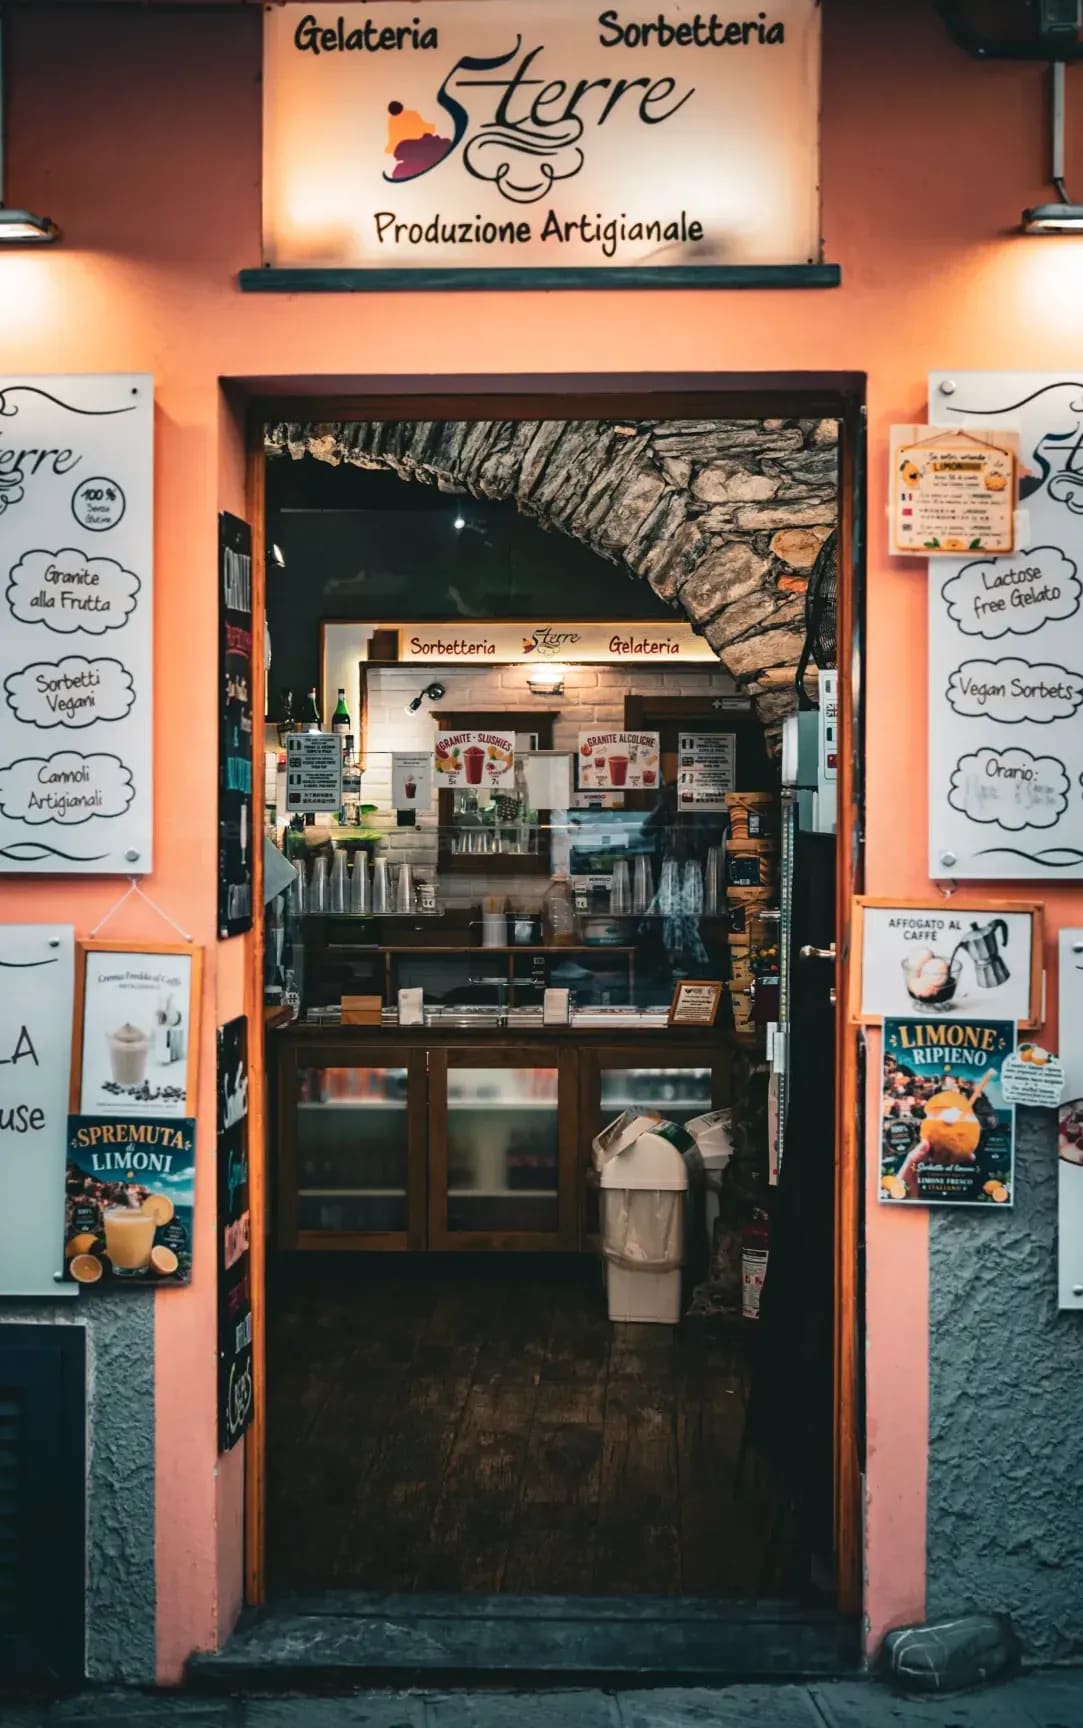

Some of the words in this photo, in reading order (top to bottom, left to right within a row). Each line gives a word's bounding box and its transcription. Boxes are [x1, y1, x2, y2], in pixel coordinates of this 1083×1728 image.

[294, 14, 438, 54] Gelateria
[599, 11, 784, 48] Sorbetteria
[375, 211, 532, 245] Produzione
[540, 210, 704, 257] Artigianale
[44, 564, 100, 586] Granite
[982, 567, 1042, 590] Lactose
[30, 590, 55, 608] alla
[61, 591, 111, 611] Frutta
[974, 596, 1006, 619] free
[1011, 585, 1061, 608] Gelato
[410, 636, 496, 655] Sorbetteria
[608, 635, 679, 655] Gelateria
[36, 669, 101, 693] Sorbetti
[960, 678, 1006, 705] Vegan
[1011, 678, 1073, 701] Sorbets
[46, 690, 96, 719] Vegani
[439, 733, 471, 750] GRANITE
[478, 733, 512, 751] SLUSHIES
[587, 733, 617, 747] GRANITE
[619, 733, 656, 748] ALCOLICHE
[37, 765, 90, 784] Cannoli
[986, 758, 1039, 782] Orario:
[28, 790, 103, 817] Artigianali
[889, 918, 945, 930] AFFOGATO
[949, 920, 962, 930] AL
[898, 1024, 998, 1051] LIMONE
[912, 1047, 987, 1066] RIPIENO
[77, 1124, 185, 1149] SPREMUTA
[92, 1152, 173, 1172] LIMONI
